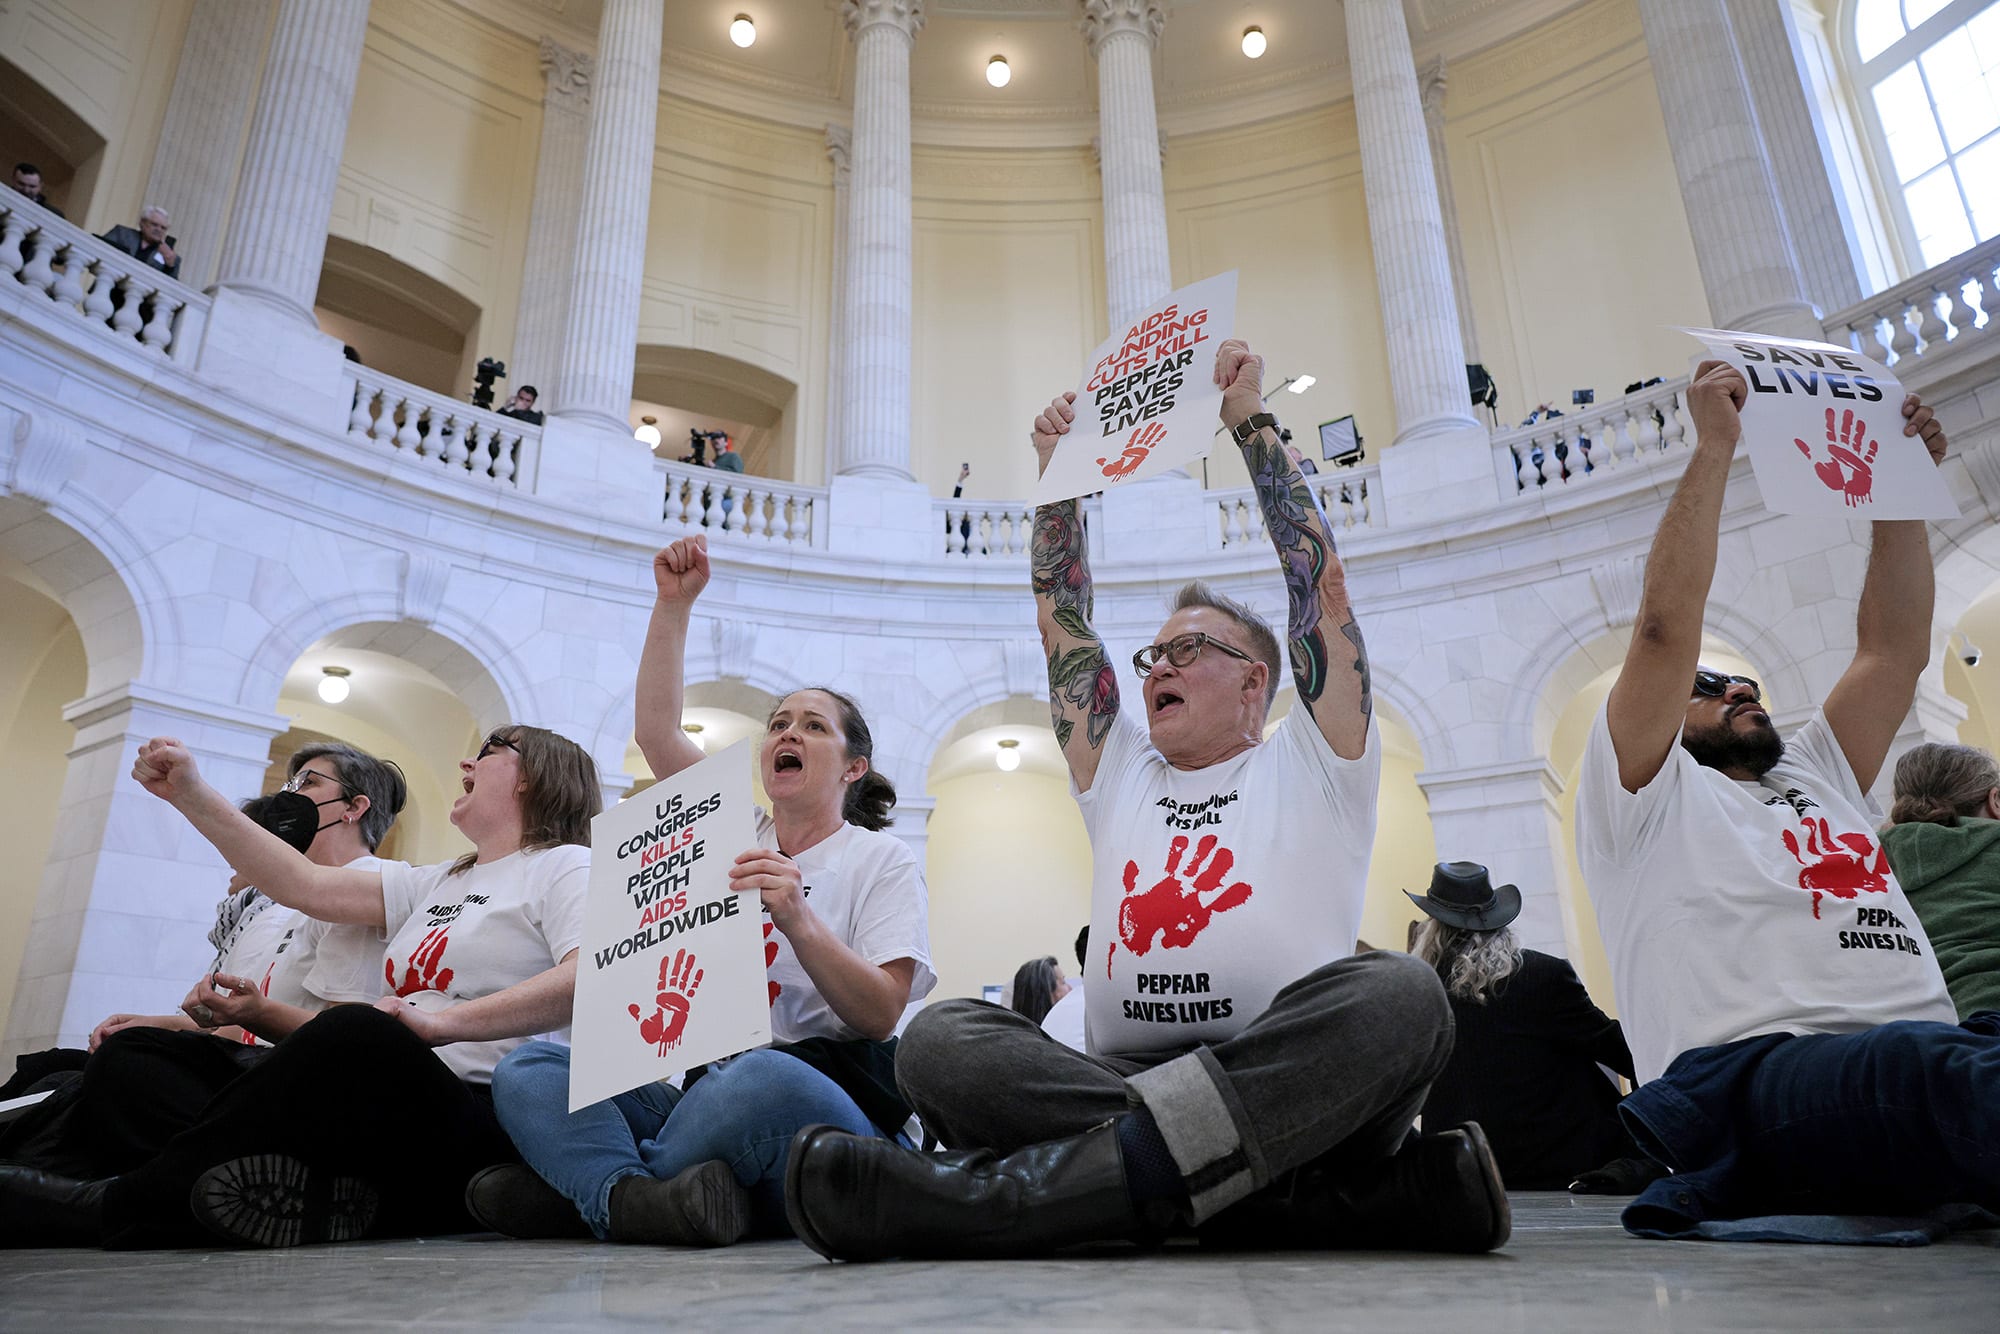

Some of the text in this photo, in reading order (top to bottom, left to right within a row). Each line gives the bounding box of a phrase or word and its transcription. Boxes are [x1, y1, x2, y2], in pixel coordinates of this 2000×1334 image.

[1094, 309, 1208, 375] FUNDING
[1123, 304, 1178, 344] AIDS
[1086, 327, 1209, 392] CUTS KILL
[1095, 349, 1193, 406] PEPFAR
[1734, 343, 1864, 372] SAVE
[1100, 372, 1183, 421] SAVES
[1745, 365, 1883, 402] LIVES
[1102, 395, 1175, 437] LIVES
[617, 793, 721, 859] CONGRESS
[656, 794, 683, 820] US
[627, 839, 705, 894] PEOPLE
[641, 827, 694, 868] KILLS
[634, 867, 690, 909] WITH
[639, 891, 687, 929] AIDS
[595, 895, 740, 970] WORLDWIDE
[1839, 931, 1895, 950] SAVES
[1137, 973, 1210, 994] PEPFAR
[1123, 998, 1233, 1023] SAVES LIVES
